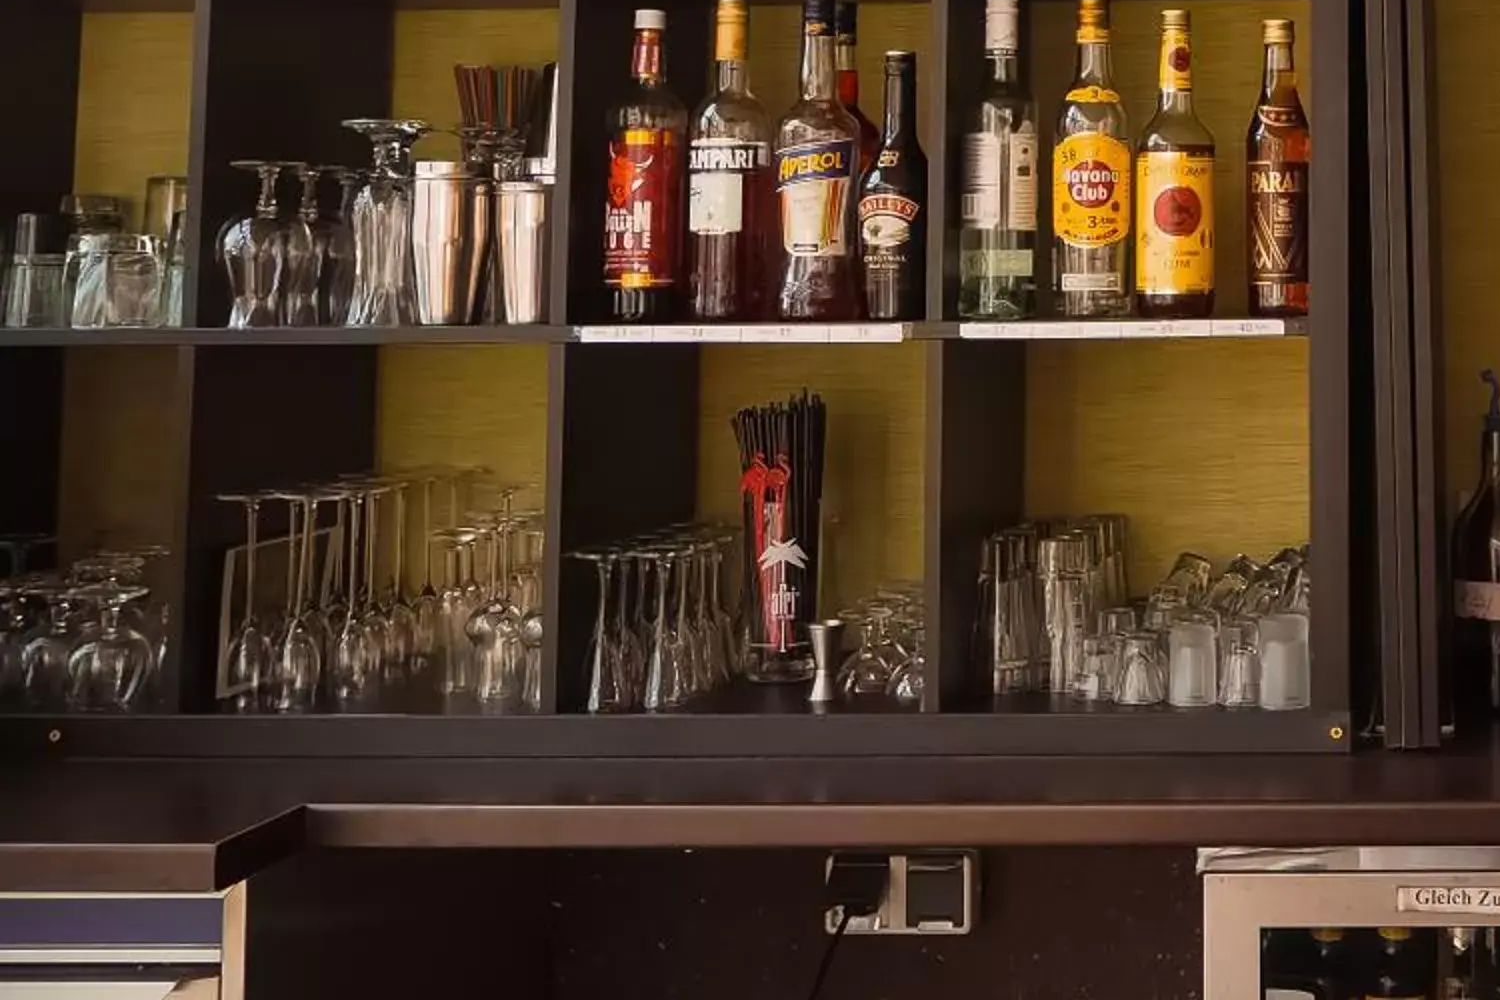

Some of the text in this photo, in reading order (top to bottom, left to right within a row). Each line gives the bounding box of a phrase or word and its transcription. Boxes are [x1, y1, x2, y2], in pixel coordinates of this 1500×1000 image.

[689, 149, 753, 169] AMPARI
[778, 152, 843, 182] APEROL
[1071, 184, 1108, 200] Club
[1415, 888, 1472, 907] Gleich
